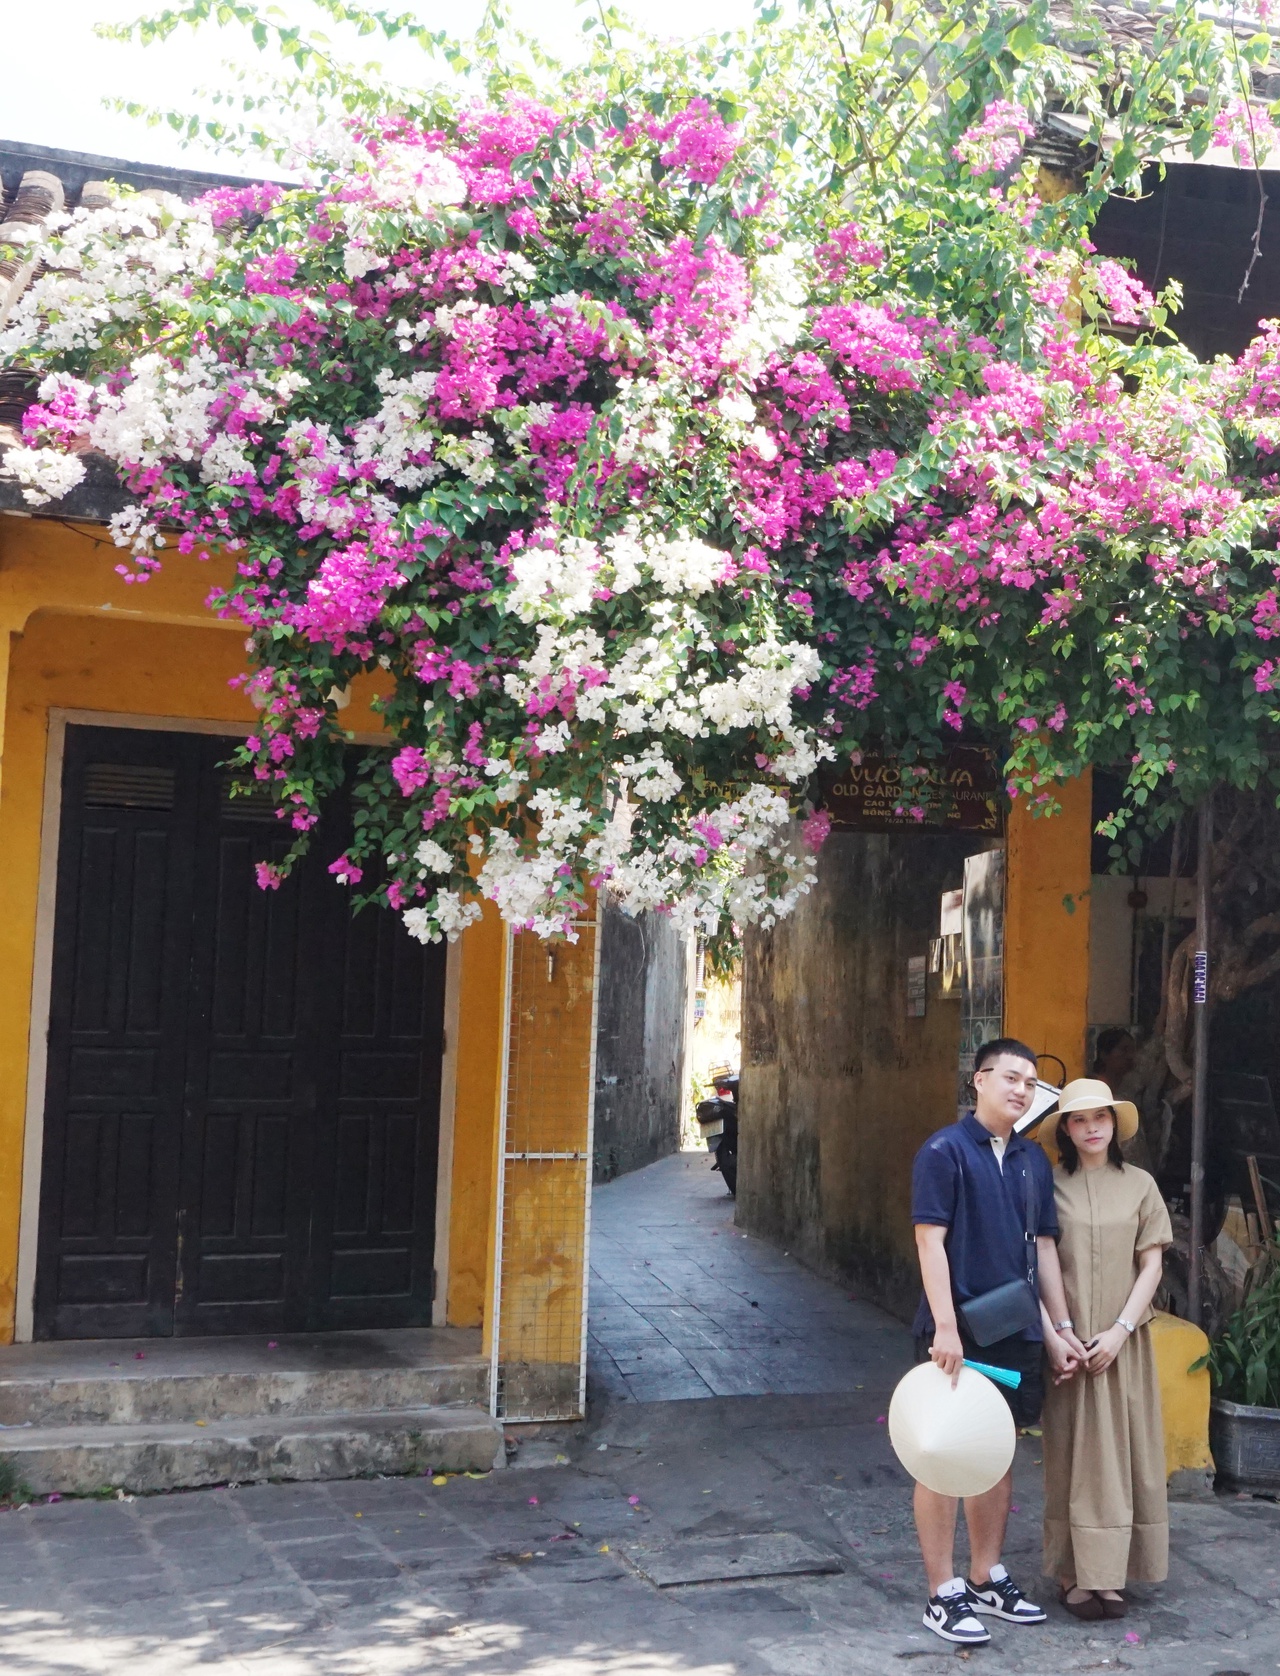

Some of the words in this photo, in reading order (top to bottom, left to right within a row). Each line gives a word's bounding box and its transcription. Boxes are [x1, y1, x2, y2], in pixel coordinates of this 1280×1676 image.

[832, 783, 859, 796] OLD
[863, 784, 922, 798] GARDN
[864, 799, 885, 807] CAO
